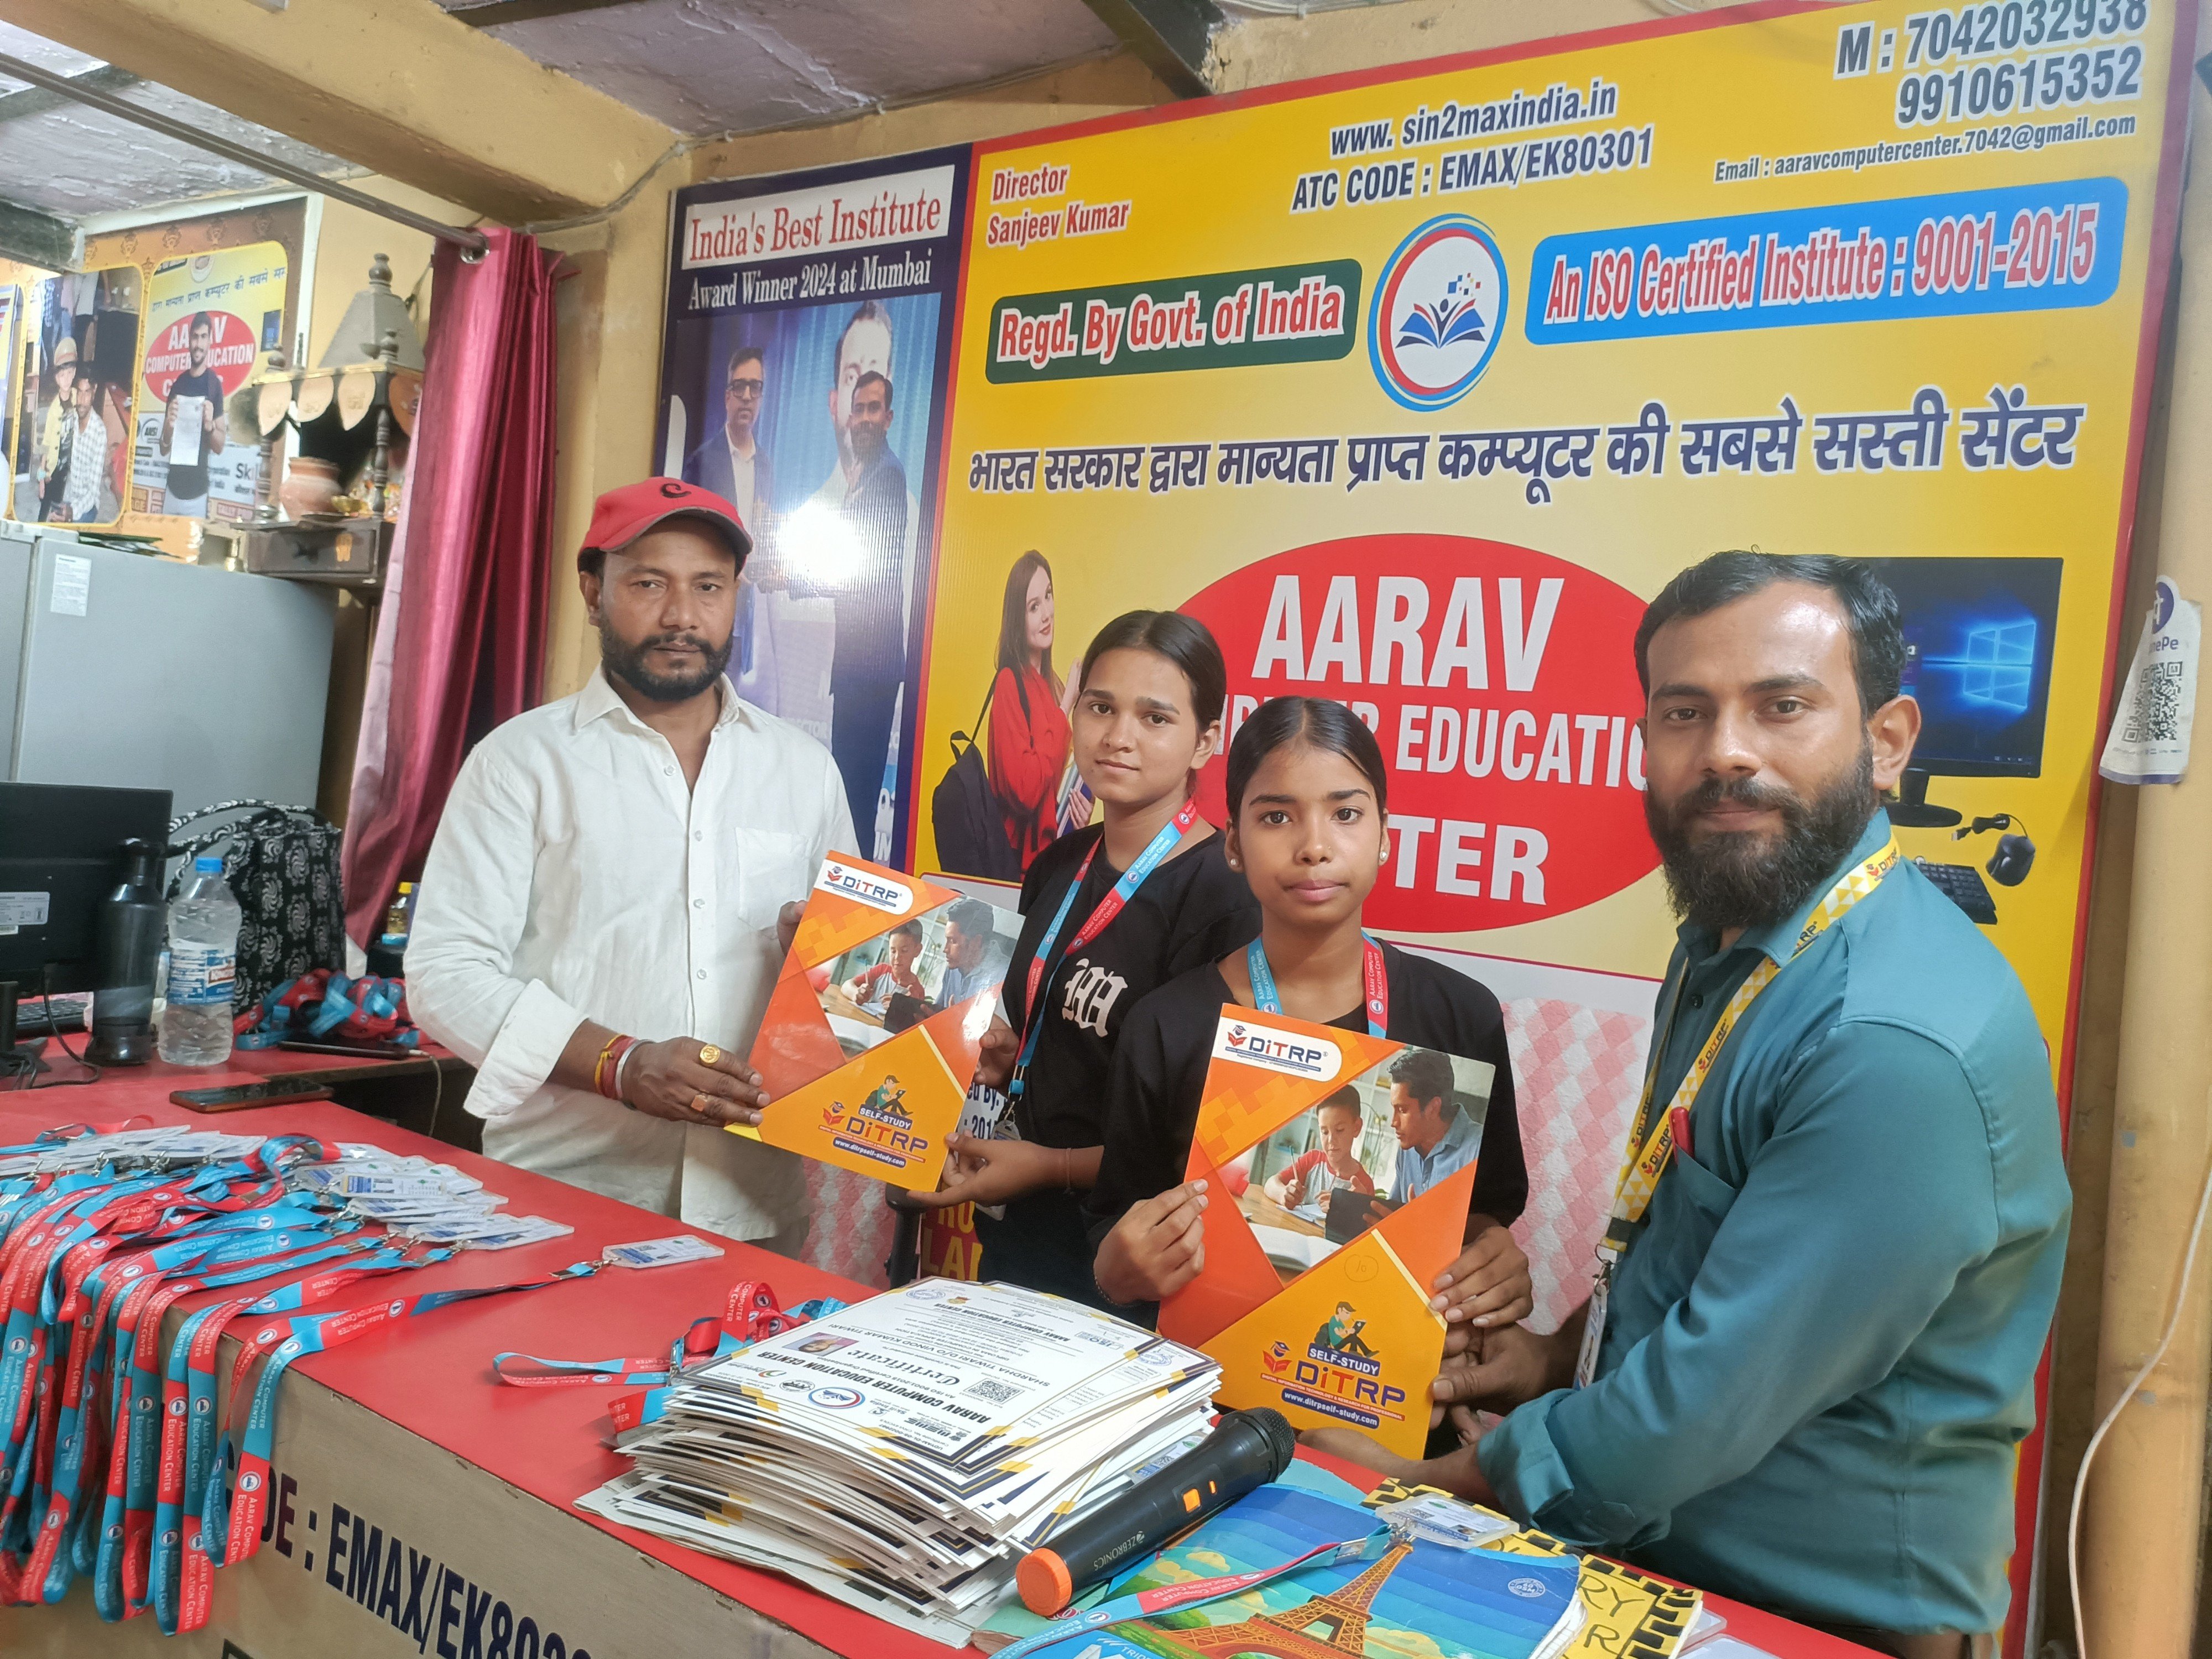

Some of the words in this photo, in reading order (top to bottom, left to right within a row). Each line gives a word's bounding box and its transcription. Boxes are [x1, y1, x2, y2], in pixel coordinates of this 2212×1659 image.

[1837, 25, 1868, 76] M
[1881, 34, 1893, 69] :
[1907, 0, 2147, 65] 7042032938
[1896, 46, 2142, 124] 9910615352
[1331, 126, 1394, 156] www.
[1401, 81, 1616, 145] sin2maxindia.in
[1715, 160, 1757, 181] Email
[1774, 116, 2135, 175] aaravcomputercenter.7042@gmail.com
[1292, 173, 1338, 211] ATC
[1346, 165, 1413, 203] CODE
[1439, 127, 1653, 191] EMAX/EK80301
[993, 168, 1068, 200] Director
[689, 212, 766, 261] India's
[771, 205, 823, 251] Best
[829, 189, 941, 243] Institute
[987, 211, 1060, 249] Sanjeev
[1067, 201, 1131, 232] Kumar
[1548, 255, 1581, 320] An
[1587, 247, 1631, 317] ISO
[1639, 237, 1755, 312] Certified
[1763, 228, 1883, 302] Institute
[1914, 206, 2098, 290] 9001-2015
[688, 273, 737, 310] Award
[742, 269, 797, 305] Winner
[800, 263, 836, 298] 2024
[839, 260, 857, 294] at
[860, 248, 932, 291] Mumbai
[999, 314, 1076, 366] Regd.
[1086, 305, 1120, 363] By
[1130, 295, 1206, 347] Govt.
[1215, 286, 1250, 338] of
[1258, 279, 1342, 335] India
[969, 450, 1037, 490] भारत
[1044, 446, 1144, 489] सरकार
[1150, 444, 1211, 493] द्वारा
[1218, 440, 1338, 485] मान्यता
[1346, 436, 1429, 492] प्राप्त
[1438, 429, 1600, 504] कम्प्यूटर
[1607, 403, 1669, 474] की
[1681, 397, 1802, 472] सबसे
[1813, 387, 1949, 467] सस्ती
[1961, 385, 2086, 467] सेंटर
[1251, 575, 1565, 692] AARAV
[860, 1107, 911, 1129] SELF-STUDY
[835, 1139, 905, 1166] www.ditrpself-study.com
[826, 1324, 864, 1333] TIWARI
[961, 1310, 1003, 1322] EDUCATION
[1000, 1320, 1045, 1333] COMPUTER
[862, 1331, 903, 1342] KUMAR
[900, 1340, 936, 1351] VINOD
[1042, 1332, 1071, 1342] AARAV
[755, 1351, 807, 1365] CENTER
[843, 1348, 964, 1387] Certificate
[956, 1355, 998, 1369] TIWARI
[1310, 1348, 1379, 1375] SELF-STUDY
[801, 1361, 875, 1384] EDUCATION
[996, 1368, 1051, 1386] SHARDHA
[866, 1400, 891, 1408] India
[869, 1380, 946, 1407] COMPUTER
[886, 1406, 908, 1415] Skill
[940, 1404, 992, 1423] AARAV
[1285, 1391, 1378, 1426] www.ditrpself-study.com
[1094, 1534, 1137, 1572] ZEBRONICS
